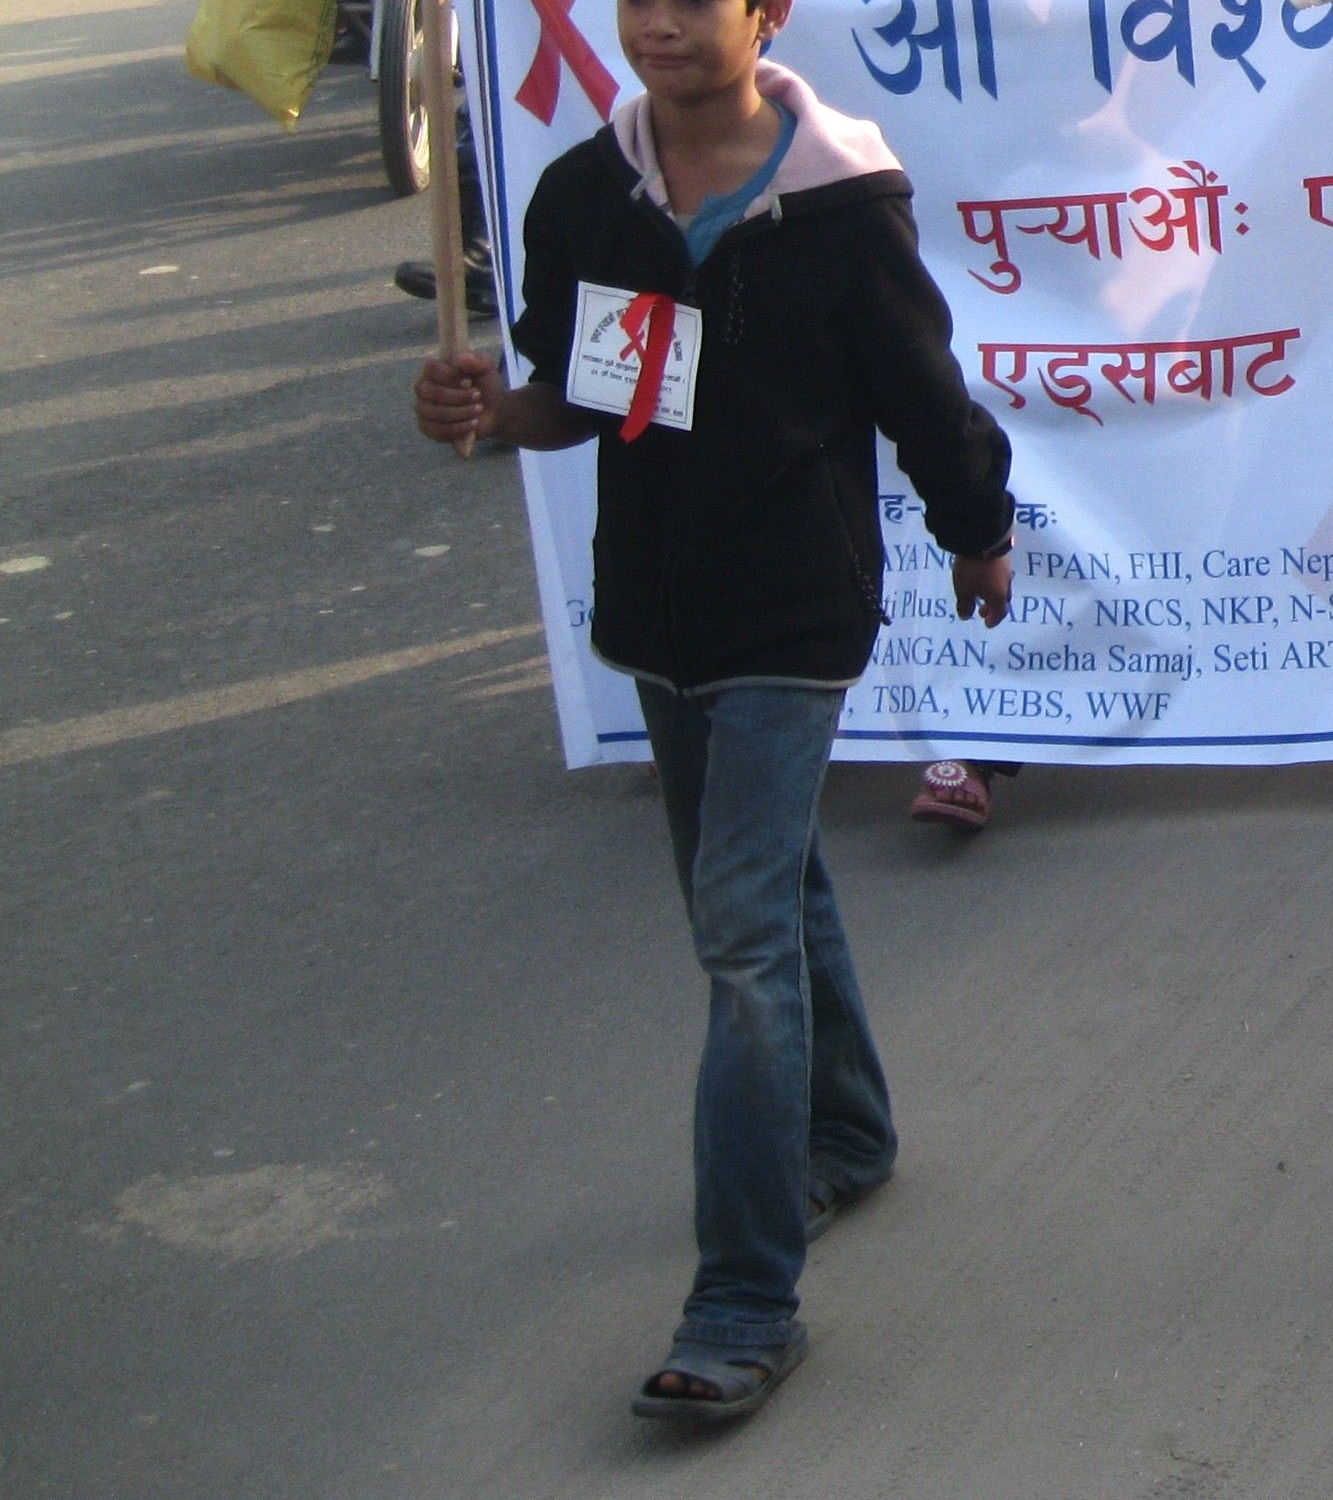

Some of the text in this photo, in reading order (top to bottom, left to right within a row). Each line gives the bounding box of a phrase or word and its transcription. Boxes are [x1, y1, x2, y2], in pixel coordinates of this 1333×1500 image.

[978, 326, 1301, 427] एड्सबाट
[1026, 549, 1121, 586] FPAN,
[1128, 551, 1193, 583] FHI,
[1202, 548, 1272, 579] Care
[902, 589, 956, 622] Plus,
[1094, 597, 1192, 631] NRCS,
[1202, 595, 1280, 628] NKP,
[1007, 641, 1097, 673] Sneha
[1107, 643, 1204, 682] Samaj,
[1213, 642, 1269, 673] Seti
[873, 685, 1172, 722] TSDA, WEBS, WWF
